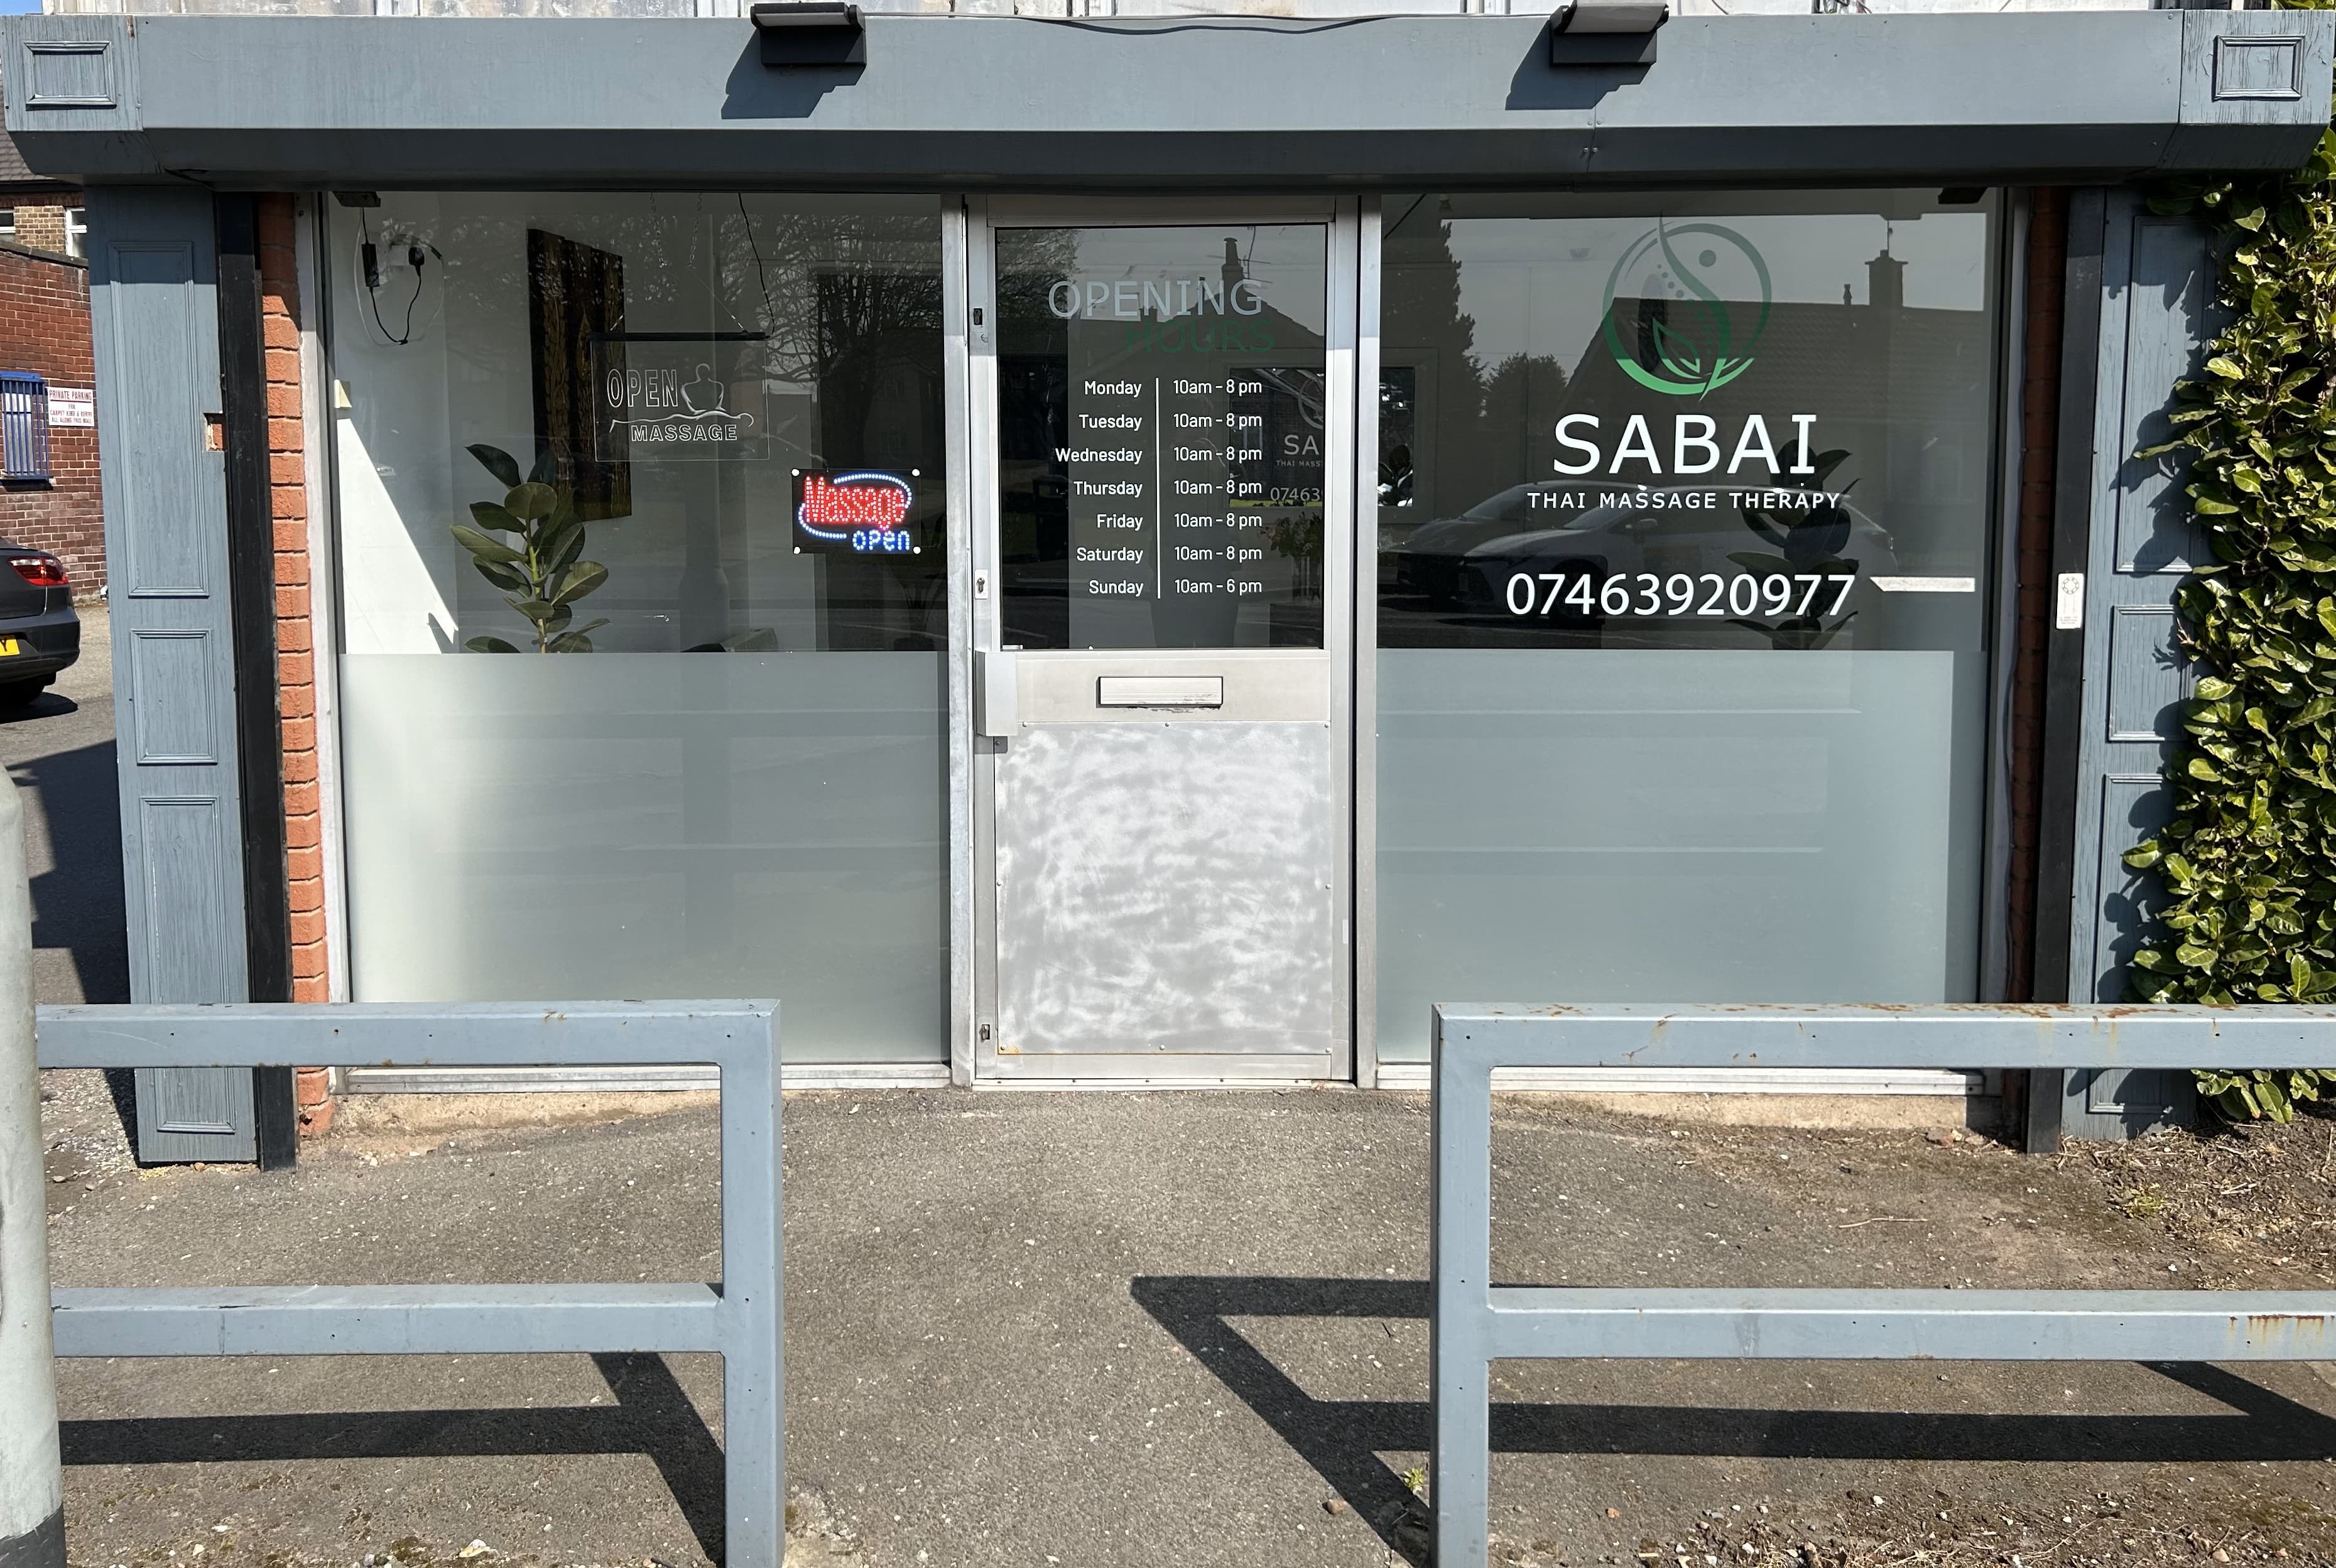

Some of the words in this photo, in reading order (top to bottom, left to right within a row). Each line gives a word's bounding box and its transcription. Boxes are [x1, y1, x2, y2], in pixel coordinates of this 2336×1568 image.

[1048, 280, 1262, 318] OPENING
[1126, 320, 1275, 354] HOURS
[50, 389, 70, 399] PRIVATE
[72, 391, 92, 401] PARKING
[606, 368, 679, 408] OPEN
[1085, 380, 1142, 398] Monday
[1173, 379, 1212, 394] 10am
[1226, 379, 1235, 394] 8
[1239, 382, 1262, 397] pm
[1078, 414, 1143, 431] Tuesday
[1173, 413, 1212, 428] 10am
[1226, 413, 1235, 427] 8
[1239, 416, 1262, 430] pm
[631, 423, 738, 441] MASSAGE
[1554, 414, 1817, 475] SABAI
[1055, 447, 1143, 465] Wednesday
[1173, 446, 1212, 461] 10am
[1226, 446, 1235, 460] 8
[1239, 449, 1262, 464] pm
[1073, 480, 1143, 498] Thursday
[1174, 480, 1212, 494] 10am
[1226, 479, 1235, 494] 8
[1239, 482, 1262, 497] pm
[1270, 487, 1323, 502] 07463
[803, 475, 906, 531] Massage
[1527, 492, 1585, 509] THAI
[1600, 492, 1716, 509] MASSAGE
[1729, 492, 1841, 509] THERAPY
[1097, 514, 1143, 531] Friday
[1174, 513, 1212, 527] 10am
[1226, 512, 1235, 527] 8
[1239, 516, 1262, 530] pm
[852, 529, 911, 551] open
[1077, 546, 1143, 564] Saturday
[1174, 546, 1212, 561] 10am
[1226, 546, 1235, 560] 8
[1239, 549, 1262, 563] pm
[1089, 580, 1144, 597] Sunday
[1175, 579, 1213, 593] 10am
[1227, 578, 1236, 593] 6
[1239, 581, 1262, 596] pm
[1506, 573, 1855, 616] 07463920977
